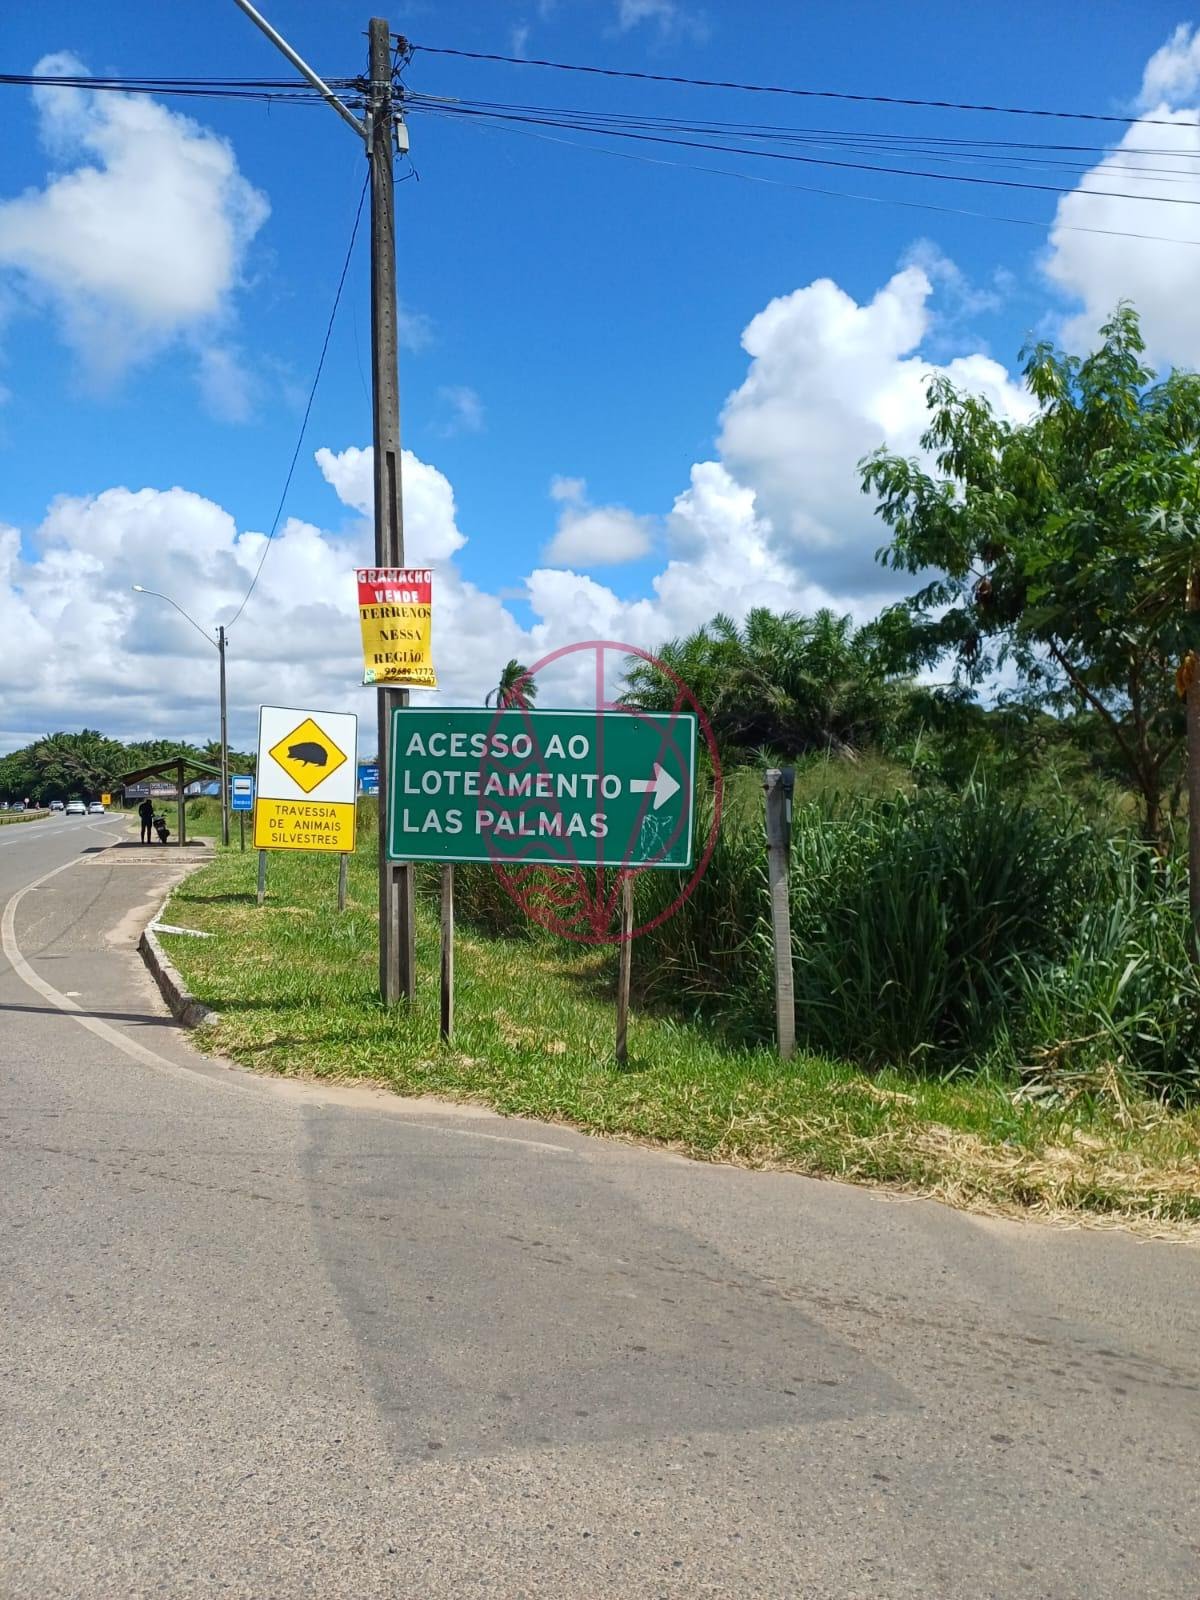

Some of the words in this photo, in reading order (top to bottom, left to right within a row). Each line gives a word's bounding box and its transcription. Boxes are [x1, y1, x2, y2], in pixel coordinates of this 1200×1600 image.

[358, 570, 431, 584] GRAMACHO
[374, 590, 419, 603] VENDE
[360, 607, 431, 620] TERRENOS
[380, 630, 422, 640] NESSA
[405, 732, 532, 758] ACESSO
[544, 734, 589, 759] AO
[404, 770, 622, 799] LOTEAMENTO
[275, 805, 336, 818] TRAVESSIA
[270, 819, 284, 828] DE
[294, 820, 341, 832] ANIMAIS
[403, 808, 463, 834] LAS
[476, 810, 608, 838] PALMAS
[272, 833, 338, 844] SILVESTRES
